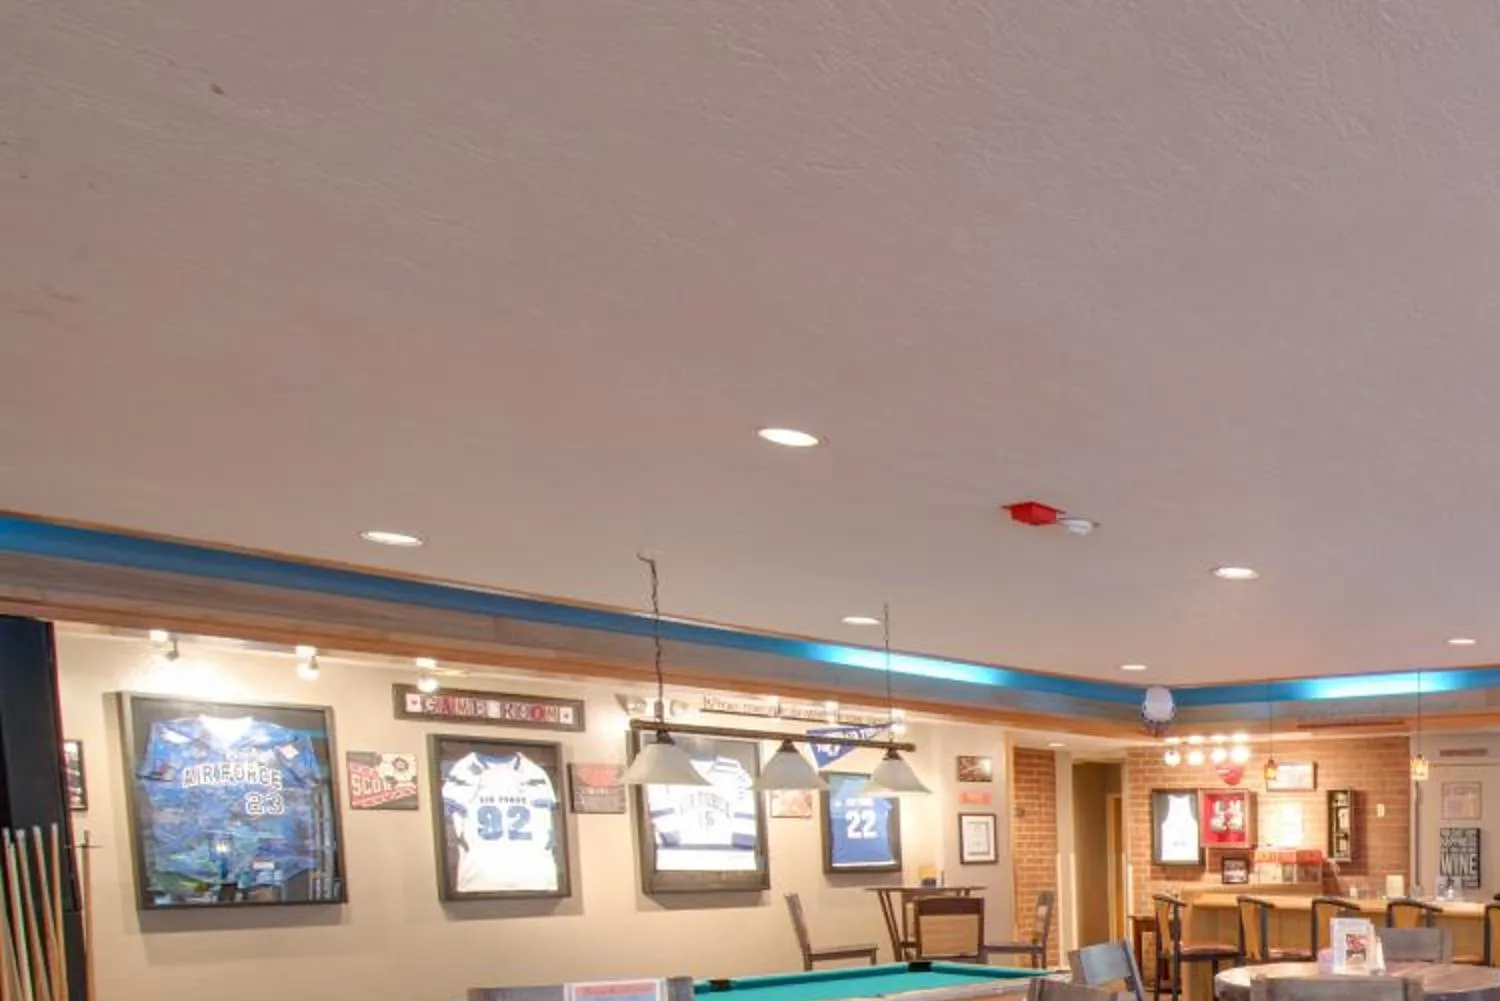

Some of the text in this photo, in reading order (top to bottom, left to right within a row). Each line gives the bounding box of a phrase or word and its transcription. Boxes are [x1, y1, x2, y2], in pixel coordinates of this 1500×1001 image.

[219, 763, 283, 791] FORCE
[478, 805, 532, 840] 92
[845, 808, 878, 839] 22
[1440, 853, 1477, 875] WINE
